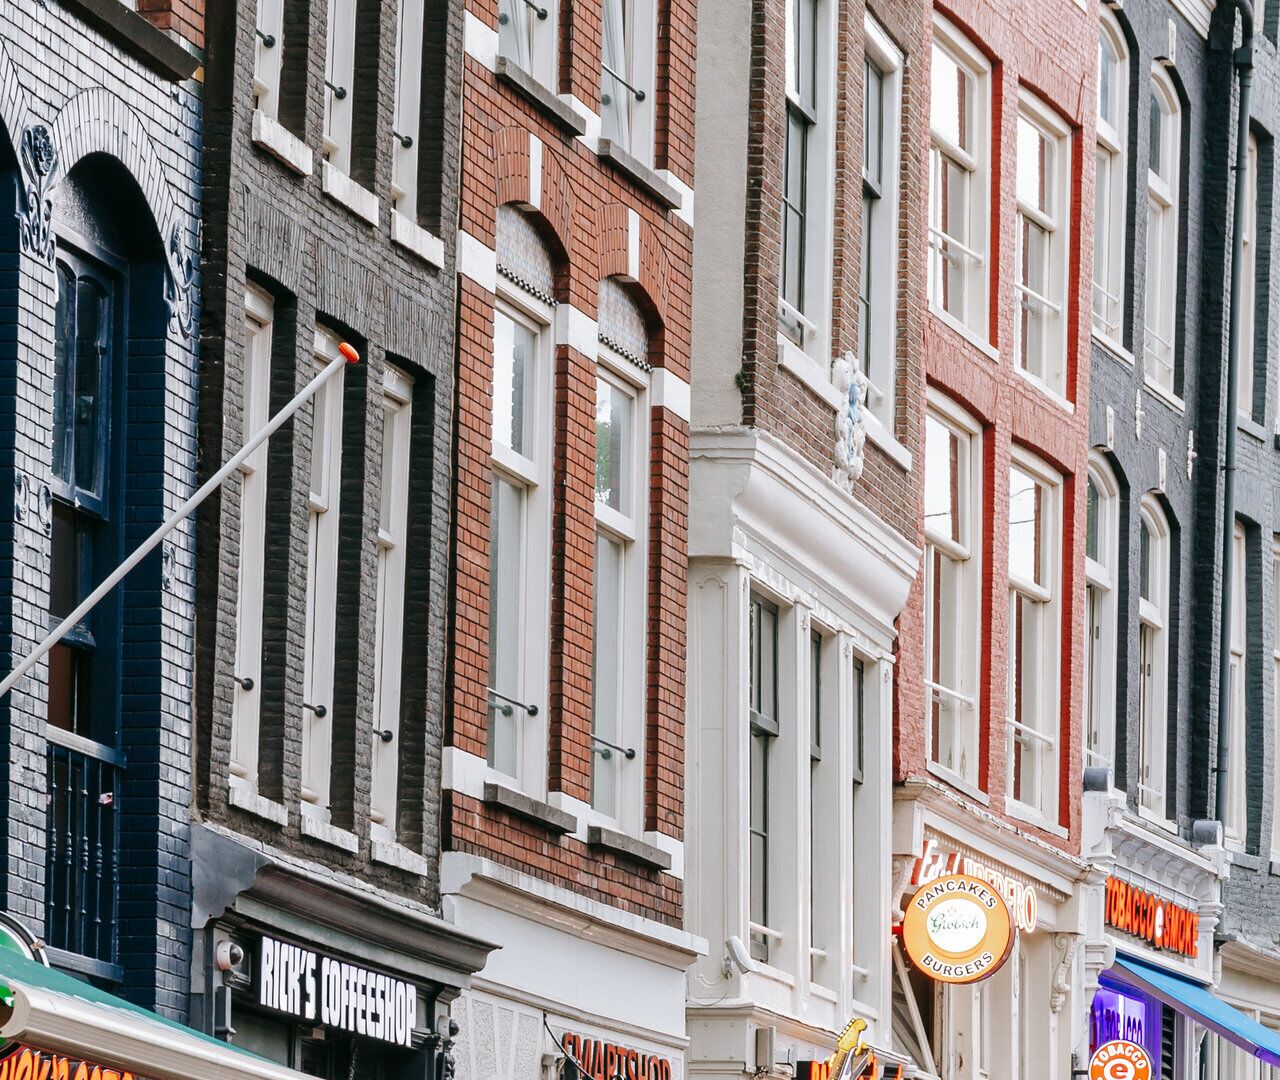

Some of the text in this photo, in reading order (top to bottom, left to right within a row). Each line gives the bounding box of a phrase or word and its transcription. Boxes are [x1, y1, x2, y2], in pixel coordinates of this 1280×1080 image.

[916, 880, 997, 909] PANCAKES
[1104, 876, 1154, 941] TOBACCO
[1163, 901, 1200, 959] SMOKE
[922, 952, 993, 977] BURGERS
[260, 935, 417, 1048] RICK'S COFFEESHOP
[1092, 1042, 1147, 1070] TOBACCO
